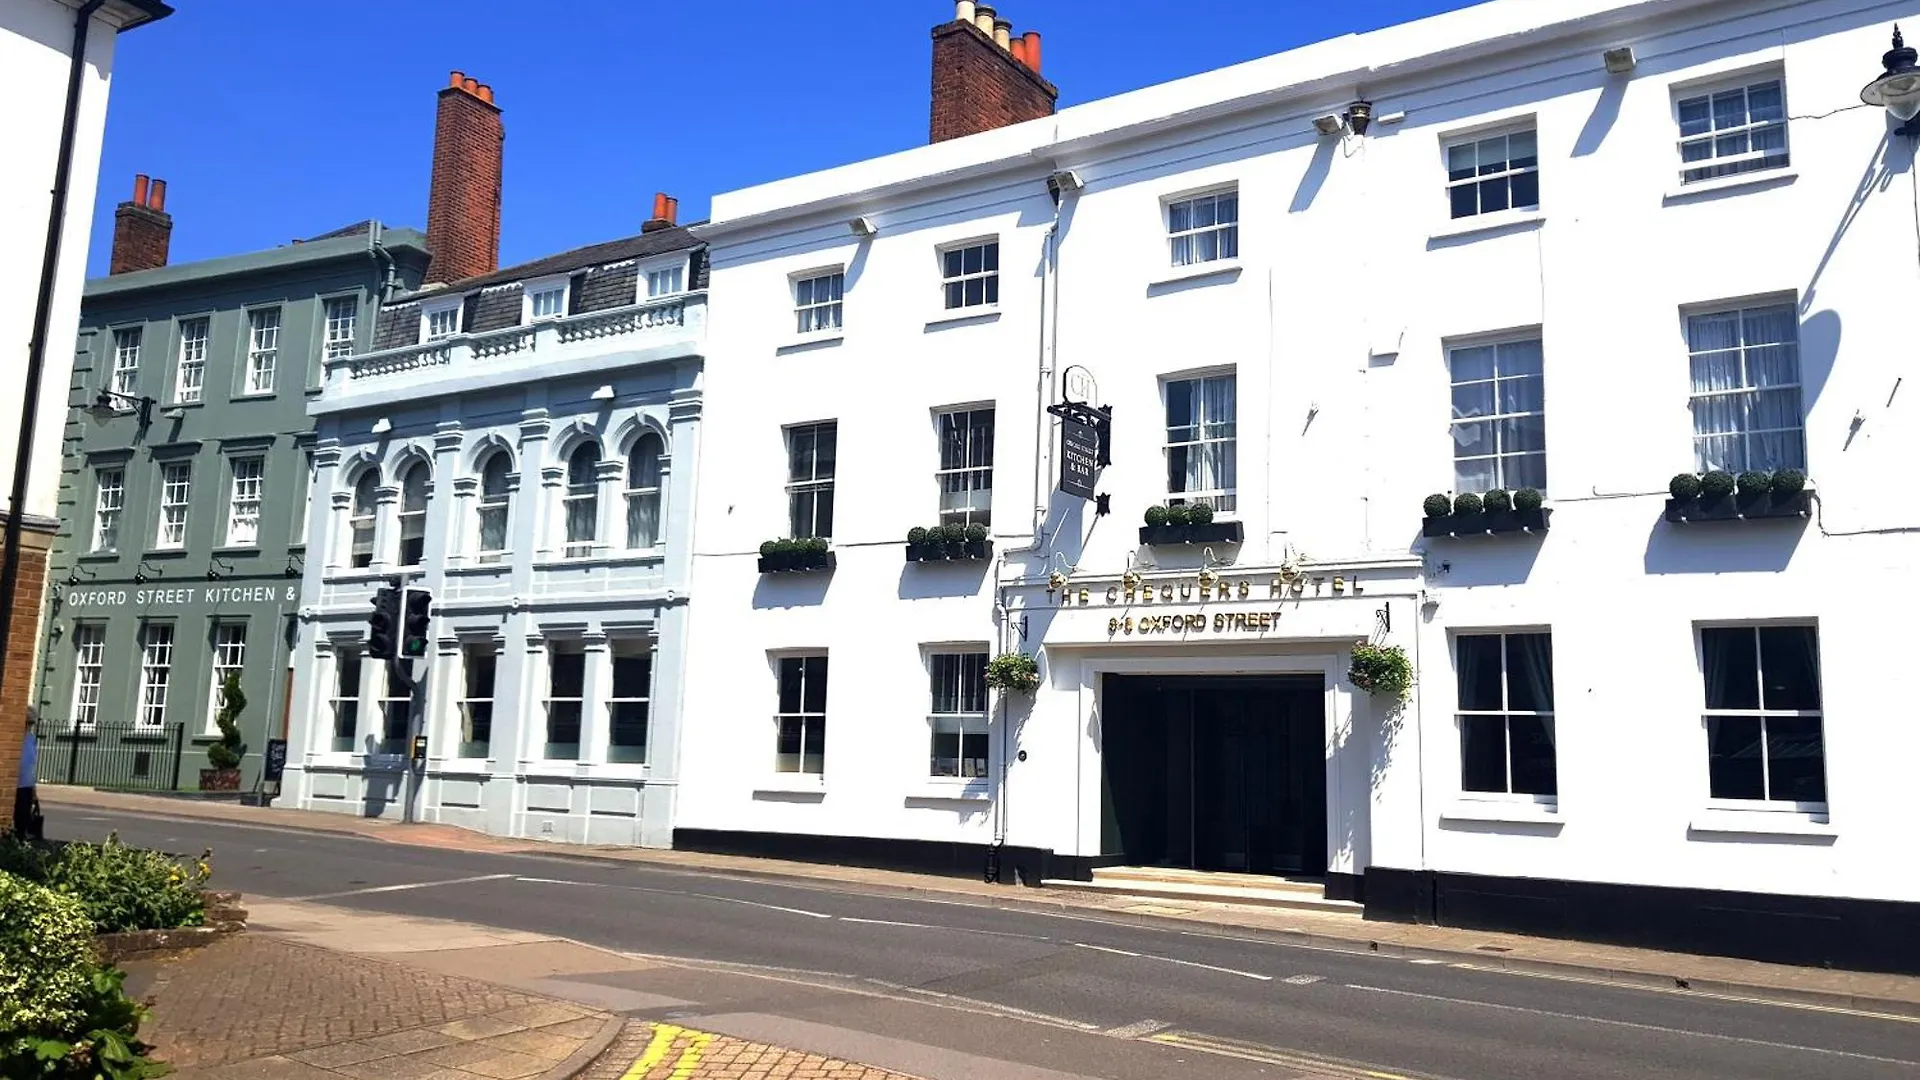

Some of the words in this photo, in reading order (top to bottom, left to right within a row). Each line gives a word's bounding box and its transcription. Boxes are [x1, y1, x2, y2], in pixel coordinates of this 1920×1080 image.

[1066, 450, 1094, 467] KITCHEN
[69, 591, 126, 606] OXFORD
[136, 589, 195, 604] STREET
[205, 587, 276, 602] KITCHEN
[285, 586, 296, 600] &
[1046, 587, 1089, 606] THE
[1105, 581, 1250, 605] CHEQUERS
[1270, 575, 1364, 600] HOTEL
[1138, 614, 1206, 633] OXFORD
[1213, 612, 1282, 632] STREET
